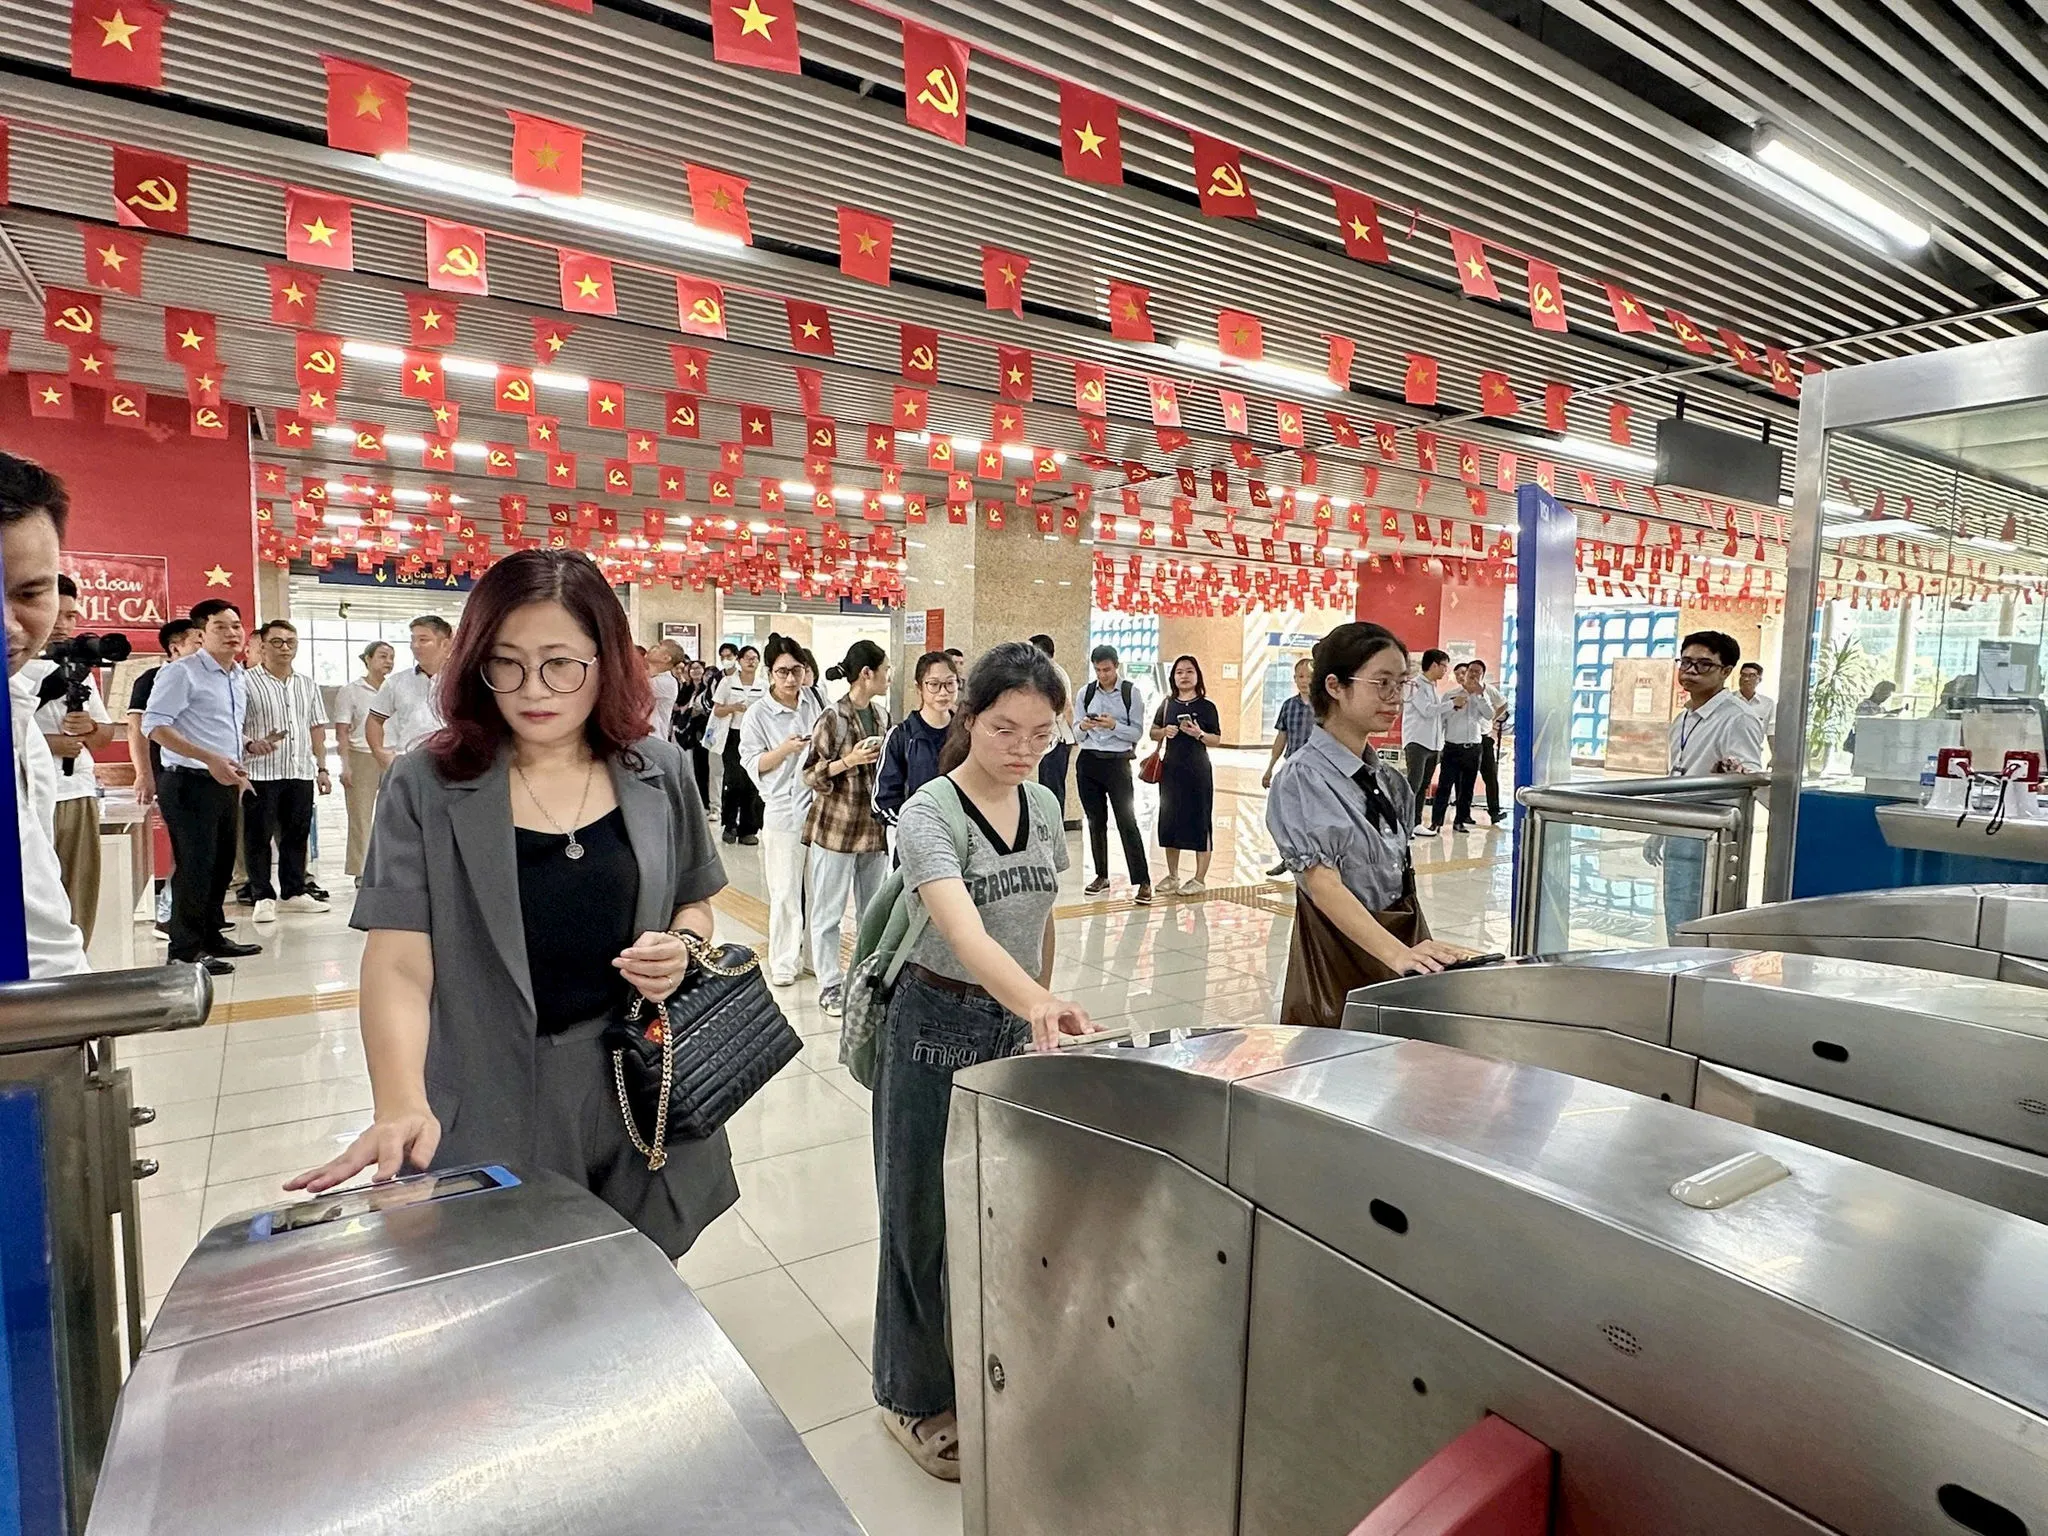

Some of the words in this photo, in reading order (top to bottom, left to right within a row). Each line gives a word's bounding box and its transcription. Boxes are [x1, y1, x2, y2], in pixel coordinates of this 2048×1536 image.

[445, 573, 459, 587] A
[75, 594, 164, 623] NH-CA
[965, 865, 1059, 907] EROCRIC
